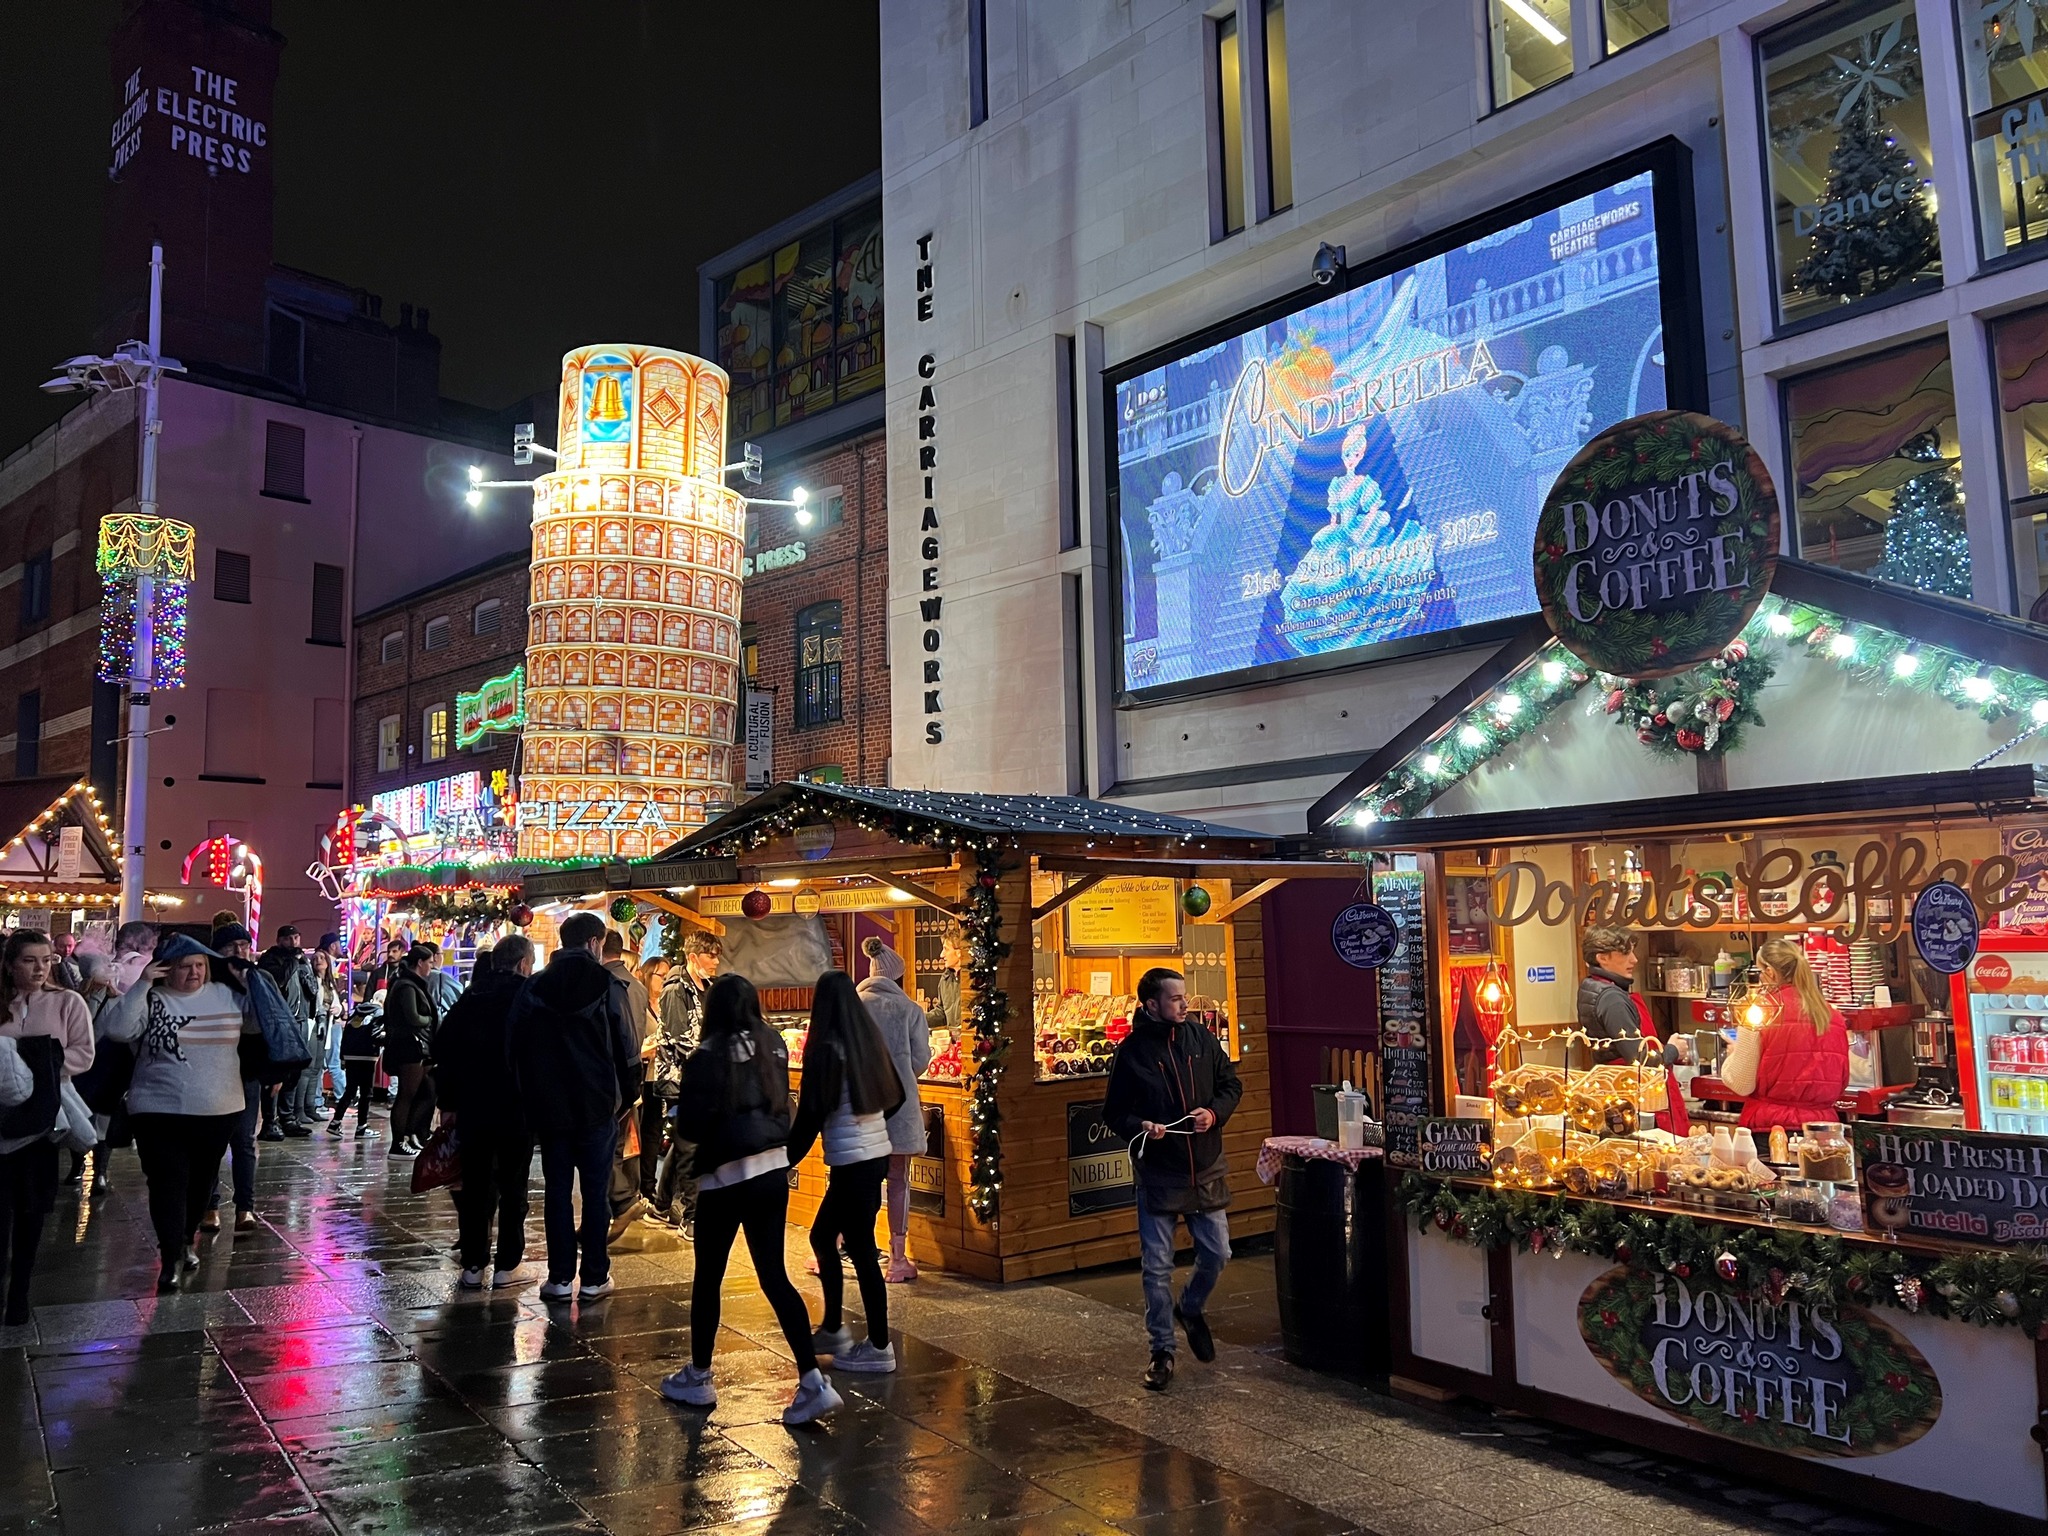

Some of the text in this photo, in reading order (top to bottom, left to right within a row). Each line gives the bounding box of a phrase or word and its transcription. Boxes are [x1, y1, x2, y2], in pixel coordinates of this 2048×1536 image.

[114, 66, 142, 106] THE
[191, 65, 238, 106] THE
[111, 88, 150, 148] ELECTRIC
[157, 86, 267, 147] ELECTRIC
[114, 125, 142, 170] PRESS
[171, 124, 251, 174] PRESS
[1549, 201, 1641, 247] CARRIAGEWORKS
[1793, 175, 1919, 238] Dance
[1550, 231, 1597, 261] THEATRE
[916, 232, 934, 322] THE
[1218, 338, 1500, 498] CINDERELLA
[1560, 459, 1739, 556] DONUTS
[756, 541, 806, 573] PRESS
[917, 354, 942, 745] CARRIAGEWORKS
[1242, 568, 1282, 599] 21st
[1441, 510, 1499, 549] 2022
[1290, 568, 1438, 612] Carriageworks Theatre
[1562, 526, 1750, 624] COFFEE
[487, 686, 514, 721] PIZZA
[759, 701, 770, 738] FUSION
[748, 701, 759, 752] CULTURAL
[515, 801, 669, 831] PIZZA
[642, 867, 657, 883] TRY
[658, 865, 688, 882] BEFORE
[689, 864, 708, 881] YOU
[708, 862, 725, 880] BUY
[1152, 879, 1170, 892] Cheese
[1383, 877, 1412, 892] MENU
[1488, 860, 1726, 929] Donuts
[1734, 837, 2032, 945] Coffee
[709, 897, 783, 913] TRY BEFO UY
[1345, 908, 1379, 922] Cadbury
[1930, 888, 1964, 909] Cadbury
[2014, 901, 2046, 915] Cream
[22, 920, 47, 928] HERE
[1383, 1047, 1426, 1061] HOT FRESH
[1425, 1121, 1484, 1144] GIANT
[1435, 1142, 1480, 1153] HOME MADE
[1424, 1151, 1491, 1172] COOKIES
[1877, 1133, 1935, 1165] HOT
[1941, 1139, 2028, 1174] FRESH
[1071, 1159, 1123, 1187] NIBBLE
[1904, 1166, 2006, 1202] LOADED
[1885, 1197, 1914, 1209] WITH
[1909, 1208, 1988, 1235] nutella
[1649, 1271, 1844, 1361] DONUTS
[1650, 1337, 1852, 1447] COFFEE
